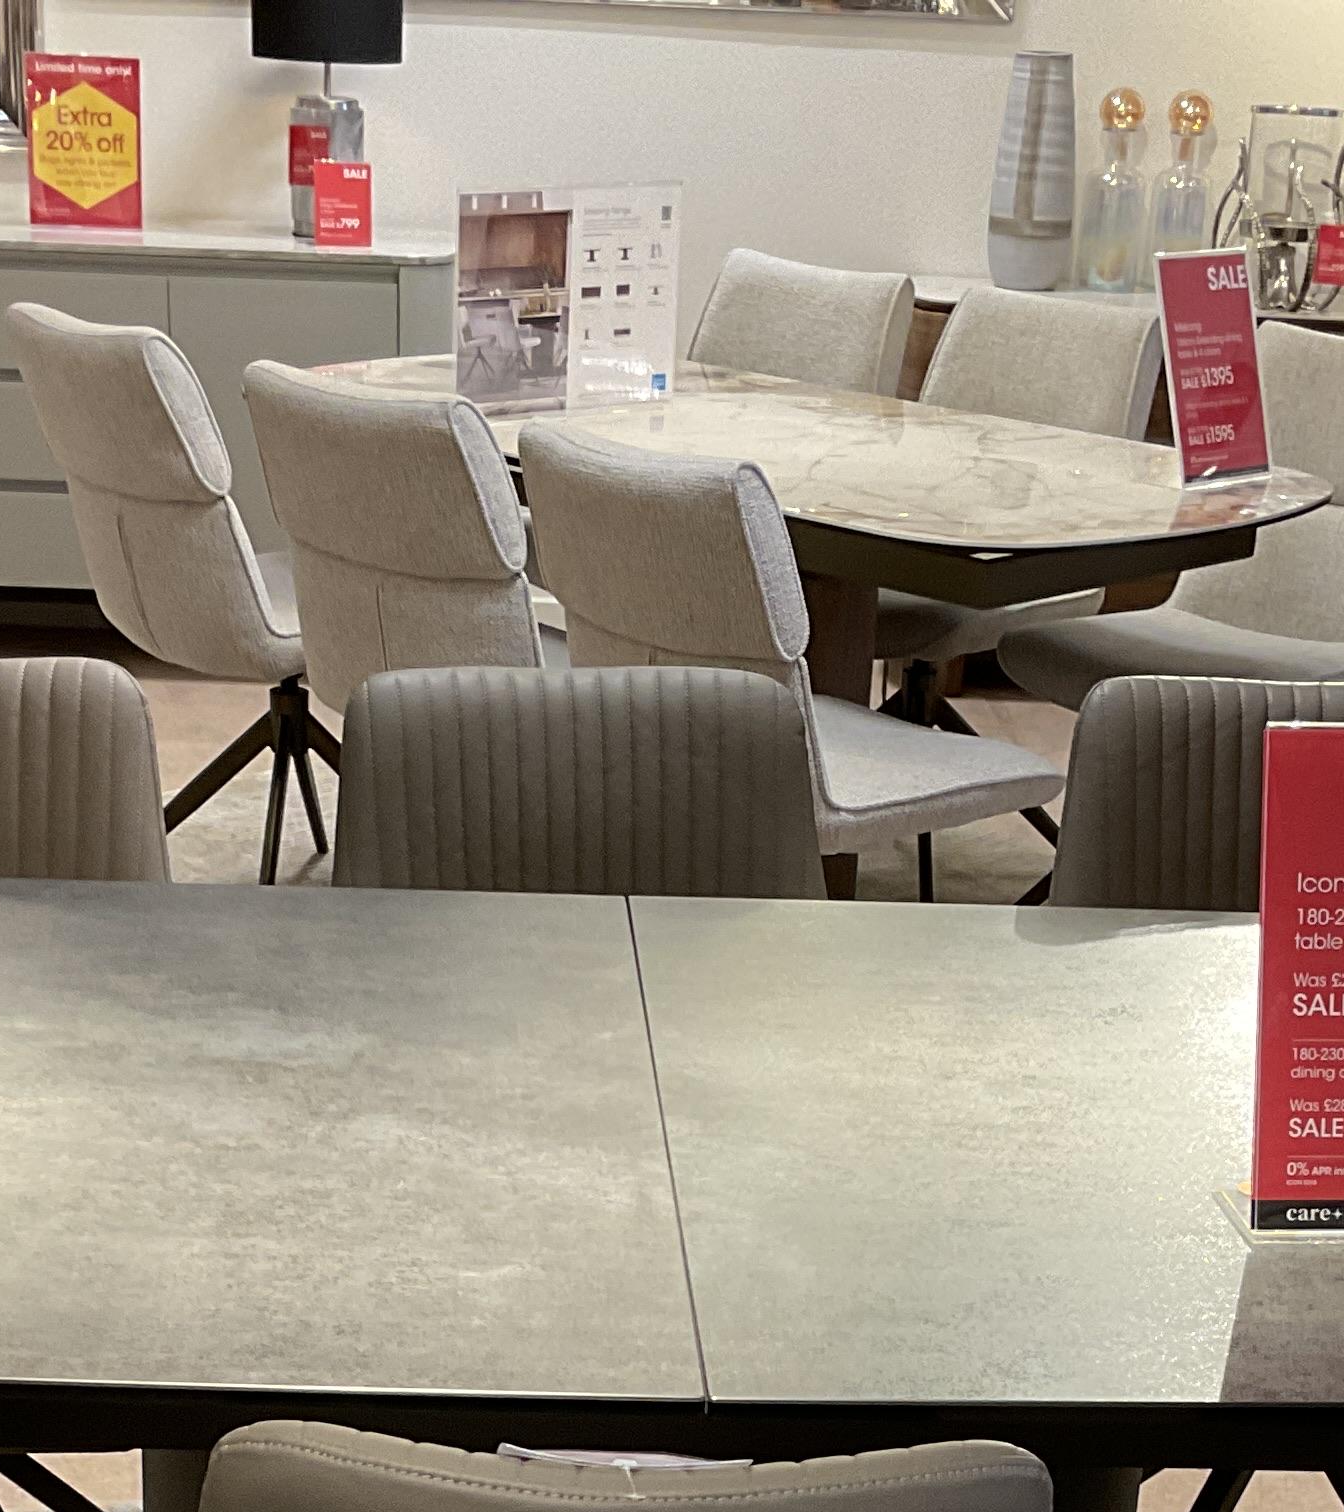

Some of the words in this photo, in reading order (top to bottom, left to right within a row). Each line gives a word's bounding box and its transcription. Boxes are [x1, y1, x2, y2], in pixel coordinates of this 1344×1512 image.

[35, 61, 75, 73] Limited
[78, 63, 102, 74] time
[57, 105, 112, 127] Extra
[46, 130, 93, 152] 20%
[97, 133, 125, 154] off
[342, 168, 368, 179] SALE
[1206, 264, 1248, 291] SALE
[1200, 366, 1234, 388] £1395
[1205, 424, 1235, 444] £1595
[1294, 932, 1343, 950] table
[1293, 972, 1327, 988] Was
[1290, 1066, 1335, 1082] dining
[1289, 1098, 1319, 1112] Was
[1288, 1117, 1344, 1138] SALE
[1286, 1161, 1309, 1176] 0%
[1311, 1166, 1332, 1176] APR
